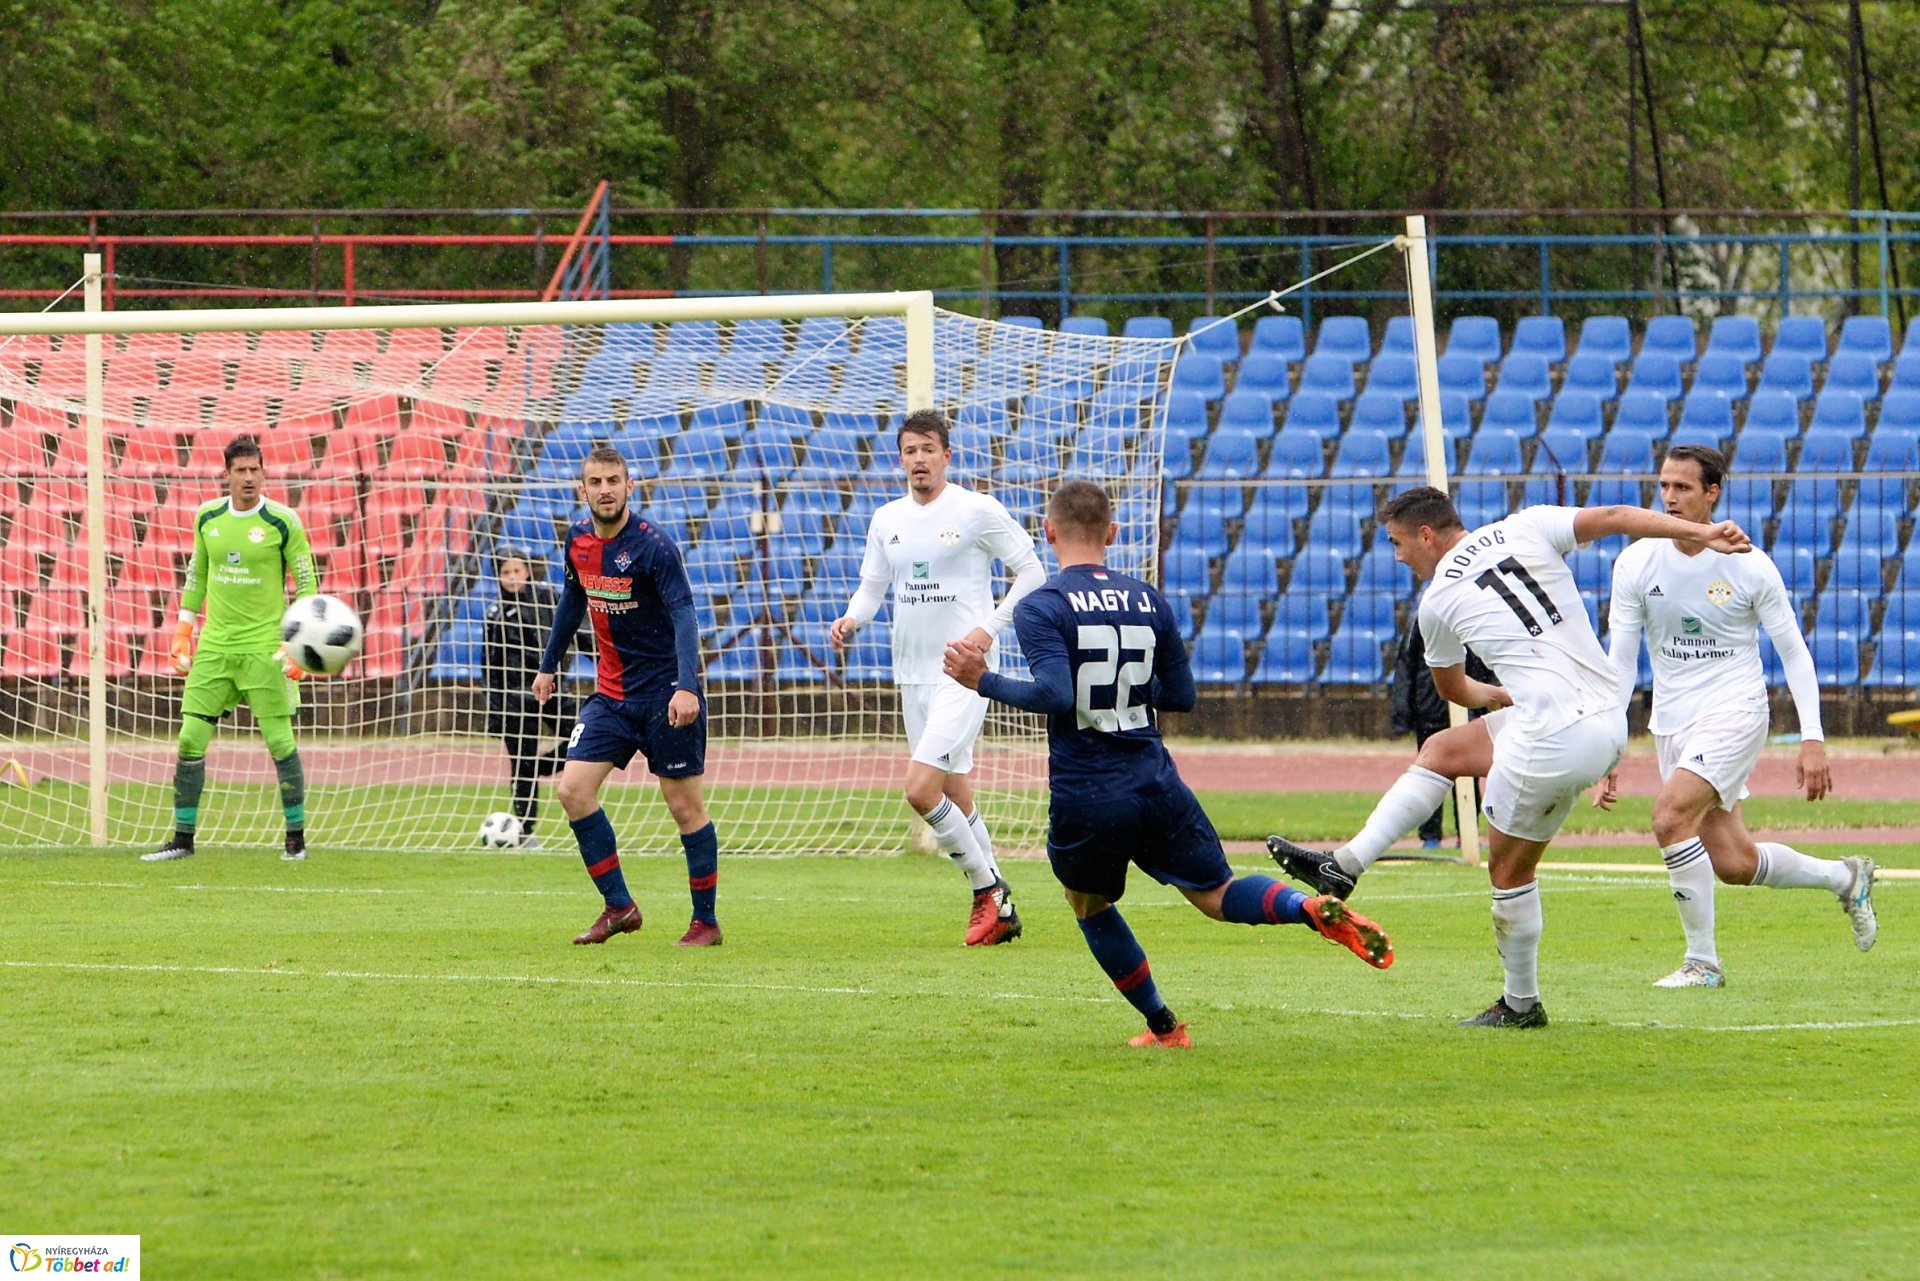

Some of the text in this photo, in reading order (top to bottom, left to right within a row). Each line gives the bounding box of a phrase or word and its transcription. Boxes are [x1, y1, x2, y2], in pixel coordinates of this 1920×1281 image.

[1445, 529, 1506, 579] DOROG
[904, 581, 940, 591] Pannon
[1068, 589, 1157, 613] NAGY J.
[1474, 556, 1563, 637] 11
[1673, 636, 1716, 647] Pannon
[1076, 624, 1157, 733] 22
